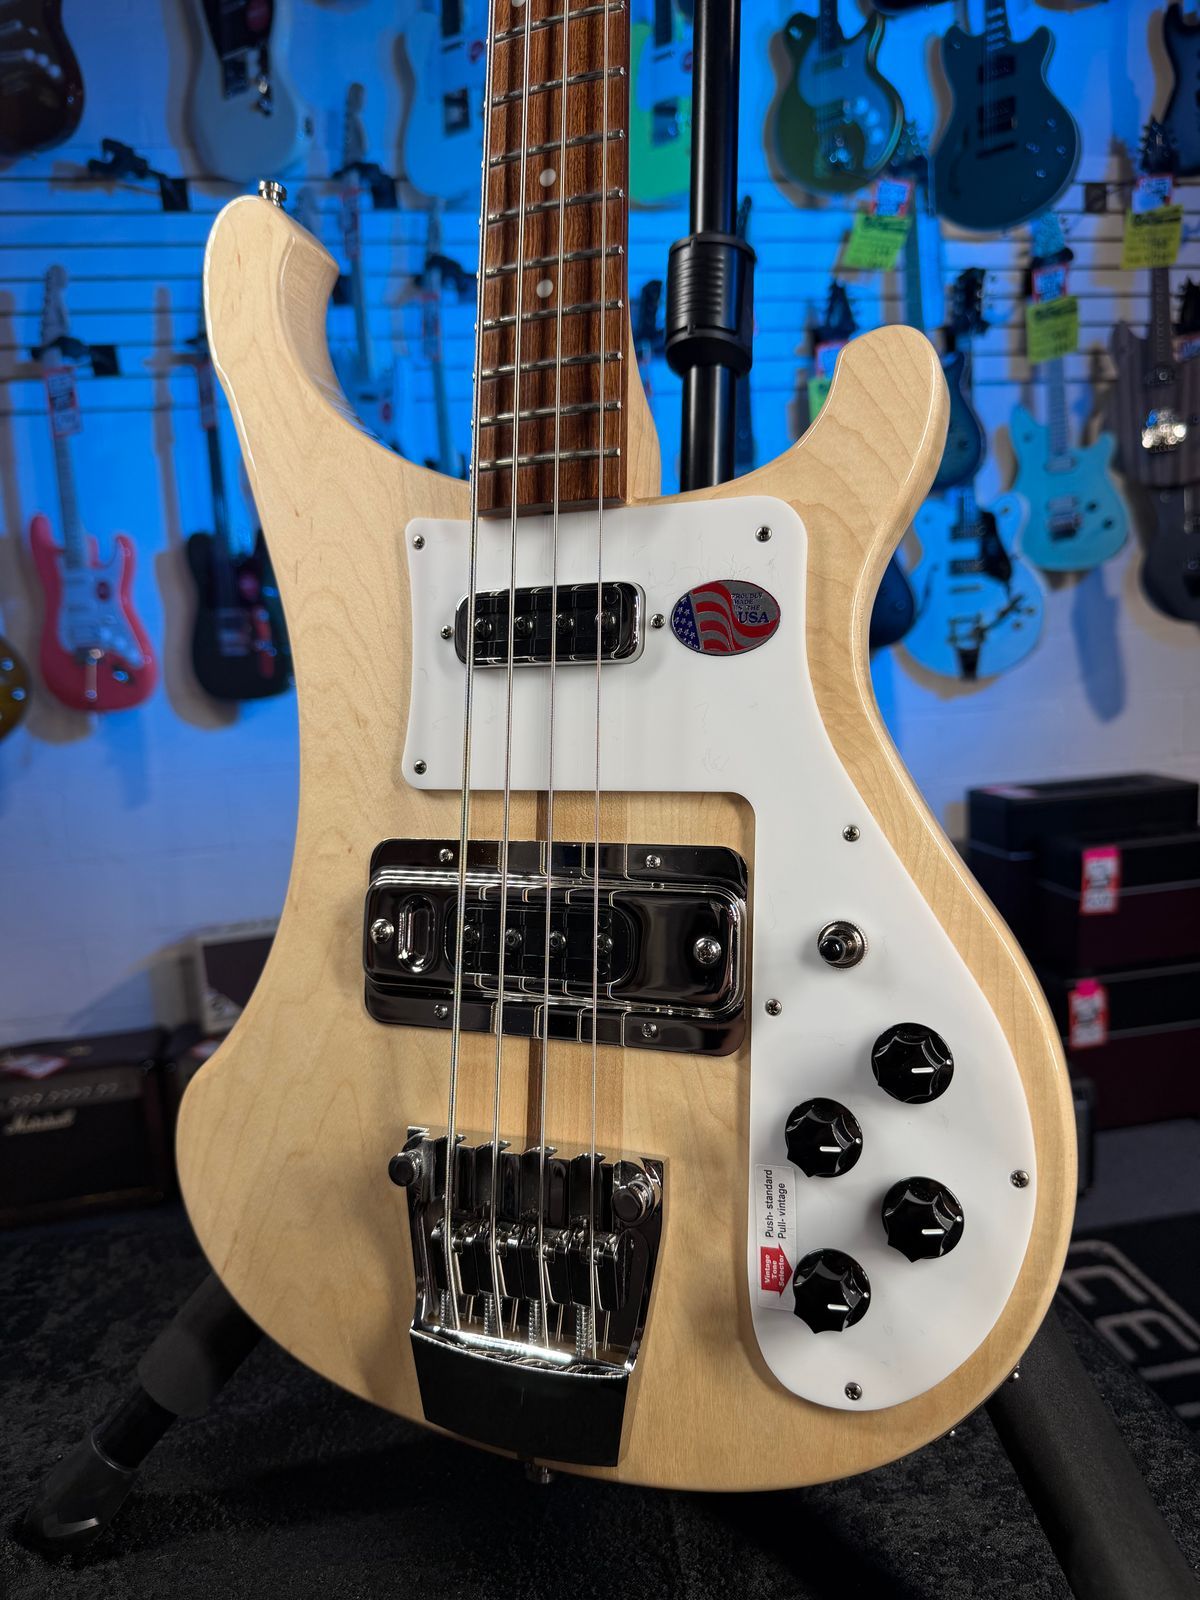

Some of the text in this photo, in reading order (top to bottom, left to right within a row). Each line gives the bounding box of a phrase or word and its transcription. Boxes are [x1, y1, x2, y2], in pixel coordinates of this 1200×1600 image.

[738, 611, 770, 624] USA
[763, 1169, 774, 1210] standard
[777, 1183, 788, 1217] vintage
[764, 1253, 772, 1284] Vintage
